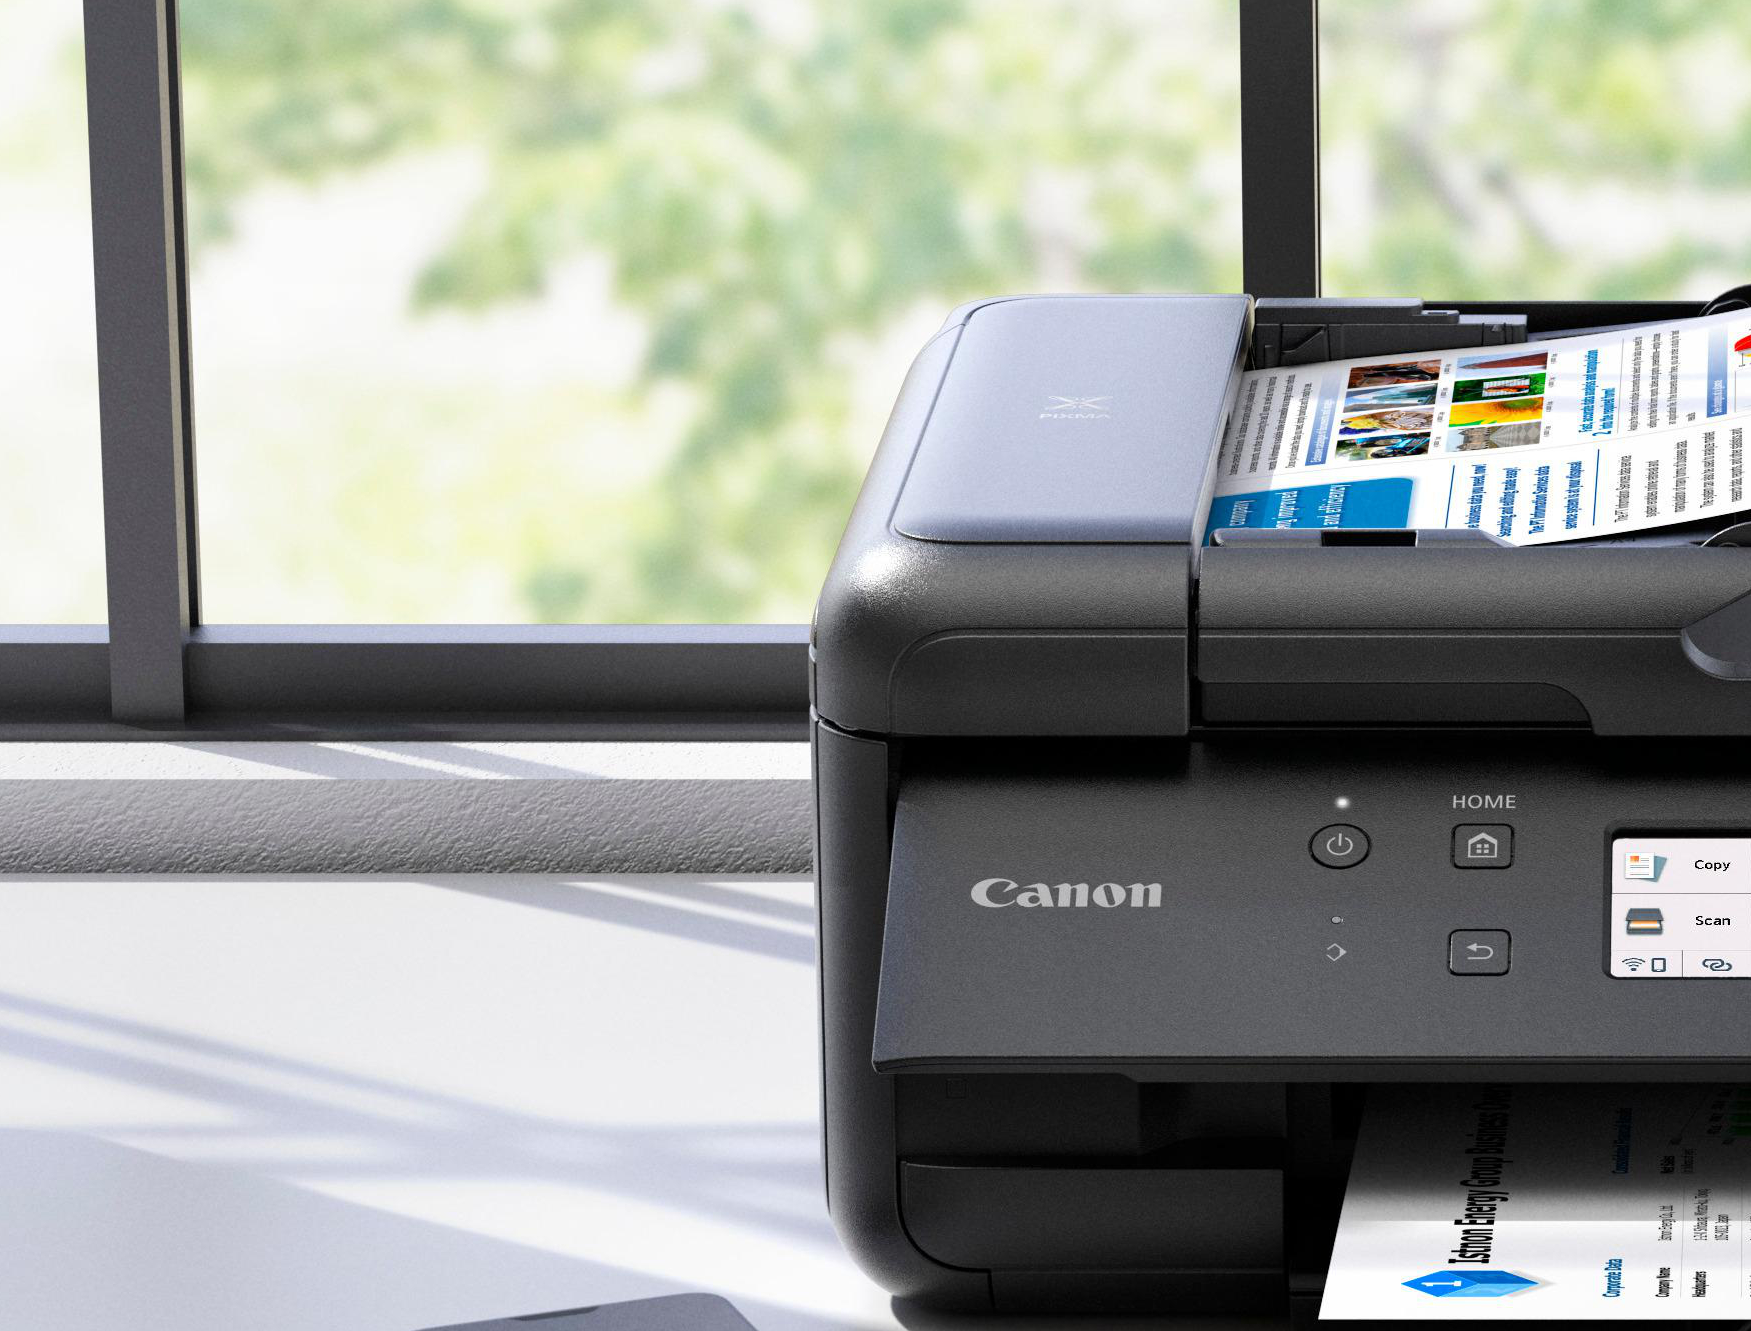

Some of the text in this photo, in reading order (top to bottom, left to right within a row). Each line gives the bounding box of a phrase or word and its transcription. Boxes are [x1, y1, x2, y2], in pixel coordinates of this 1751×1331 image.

[1534, 466, 1550, 476] data
[1532, 476, 1549, 494] Services
[1530, 494, 1547, 519] Information
[1528, 525, 1544, 534] The
[1452, 794, 1516, 809] HOME
[1694, 859, 1731, 872] Copy
[970, 878, 1162, 908] Canon
[1695, 915, 1731, 926] Scan
[1449, 1190, 1509, 1264] Istnon Energy
[1601, 1258, 1625, 1298] Corporate Data
[1654, 1267, 1673, 1298] Company Name
[1691, 1270, 1709, 1298] Headquarters
